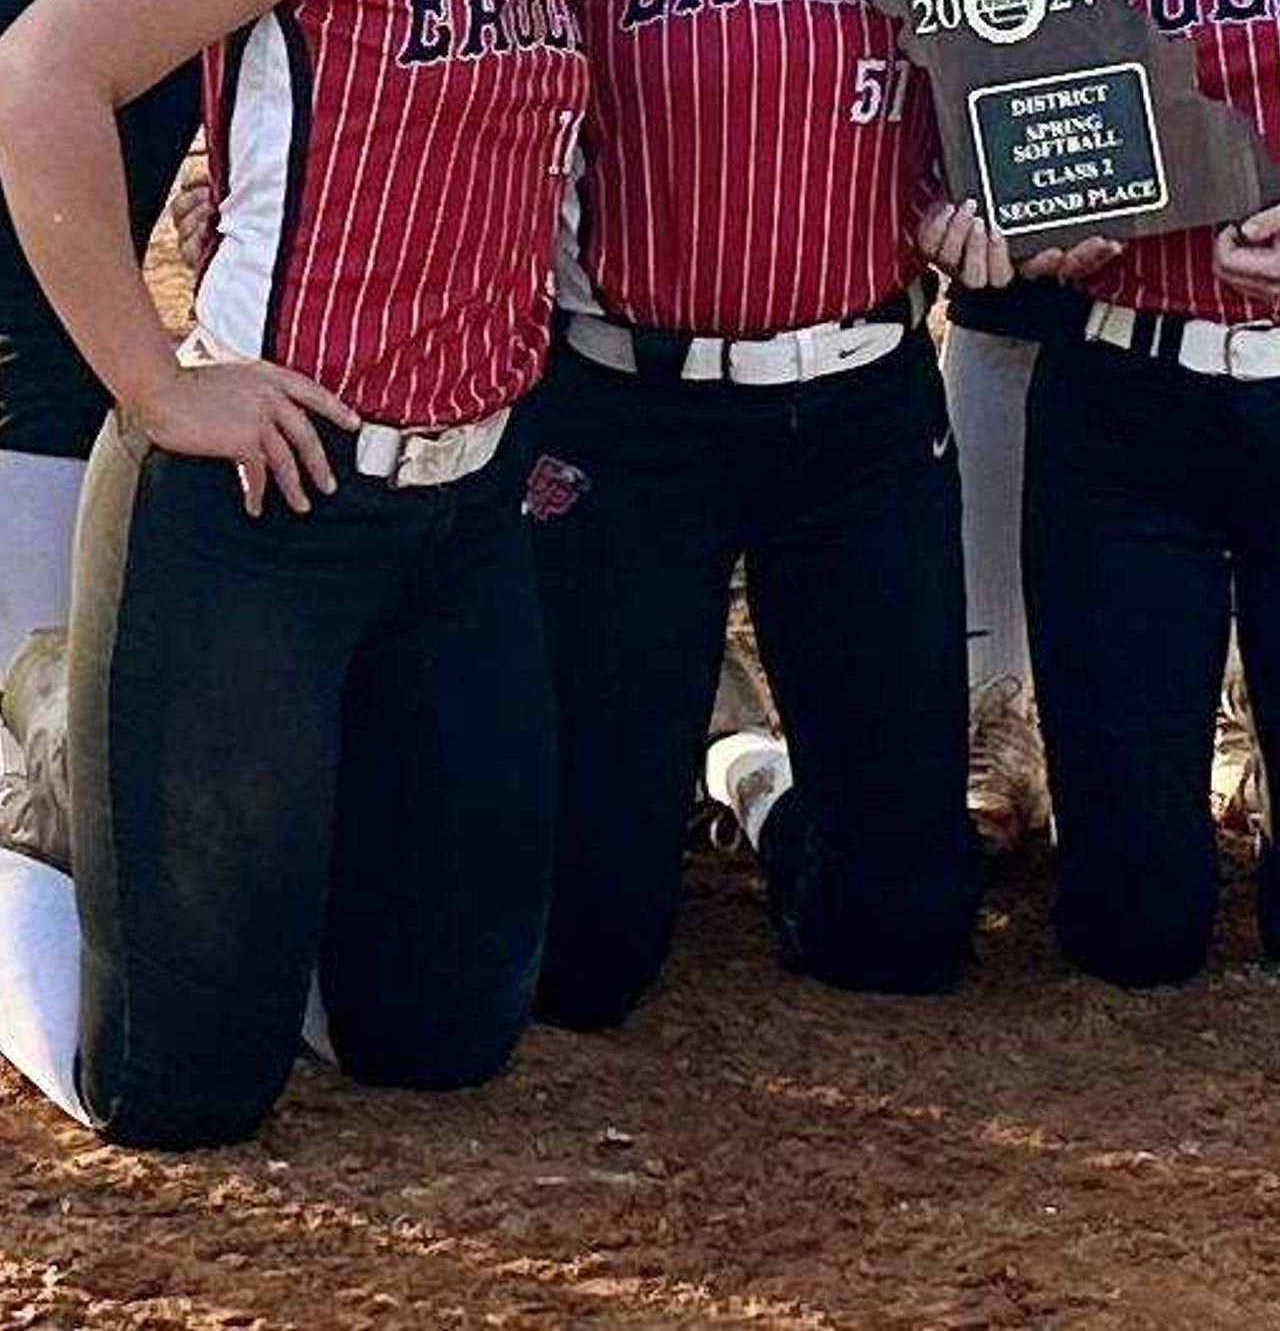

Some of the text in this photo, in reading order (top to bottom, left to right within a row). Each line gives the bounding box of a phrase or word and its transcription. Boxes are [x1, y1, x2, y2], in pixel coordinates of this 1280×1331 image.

[1010, 84, 1109, 117] DISTRICT
[1024, 112, 1104, 142] SPRING
[1012, 129, 1124, 163] SOFTBALL
[1032, 161, 1098, 188] CLASS
[998, 178, 1158, 223] SECOND PLACE
